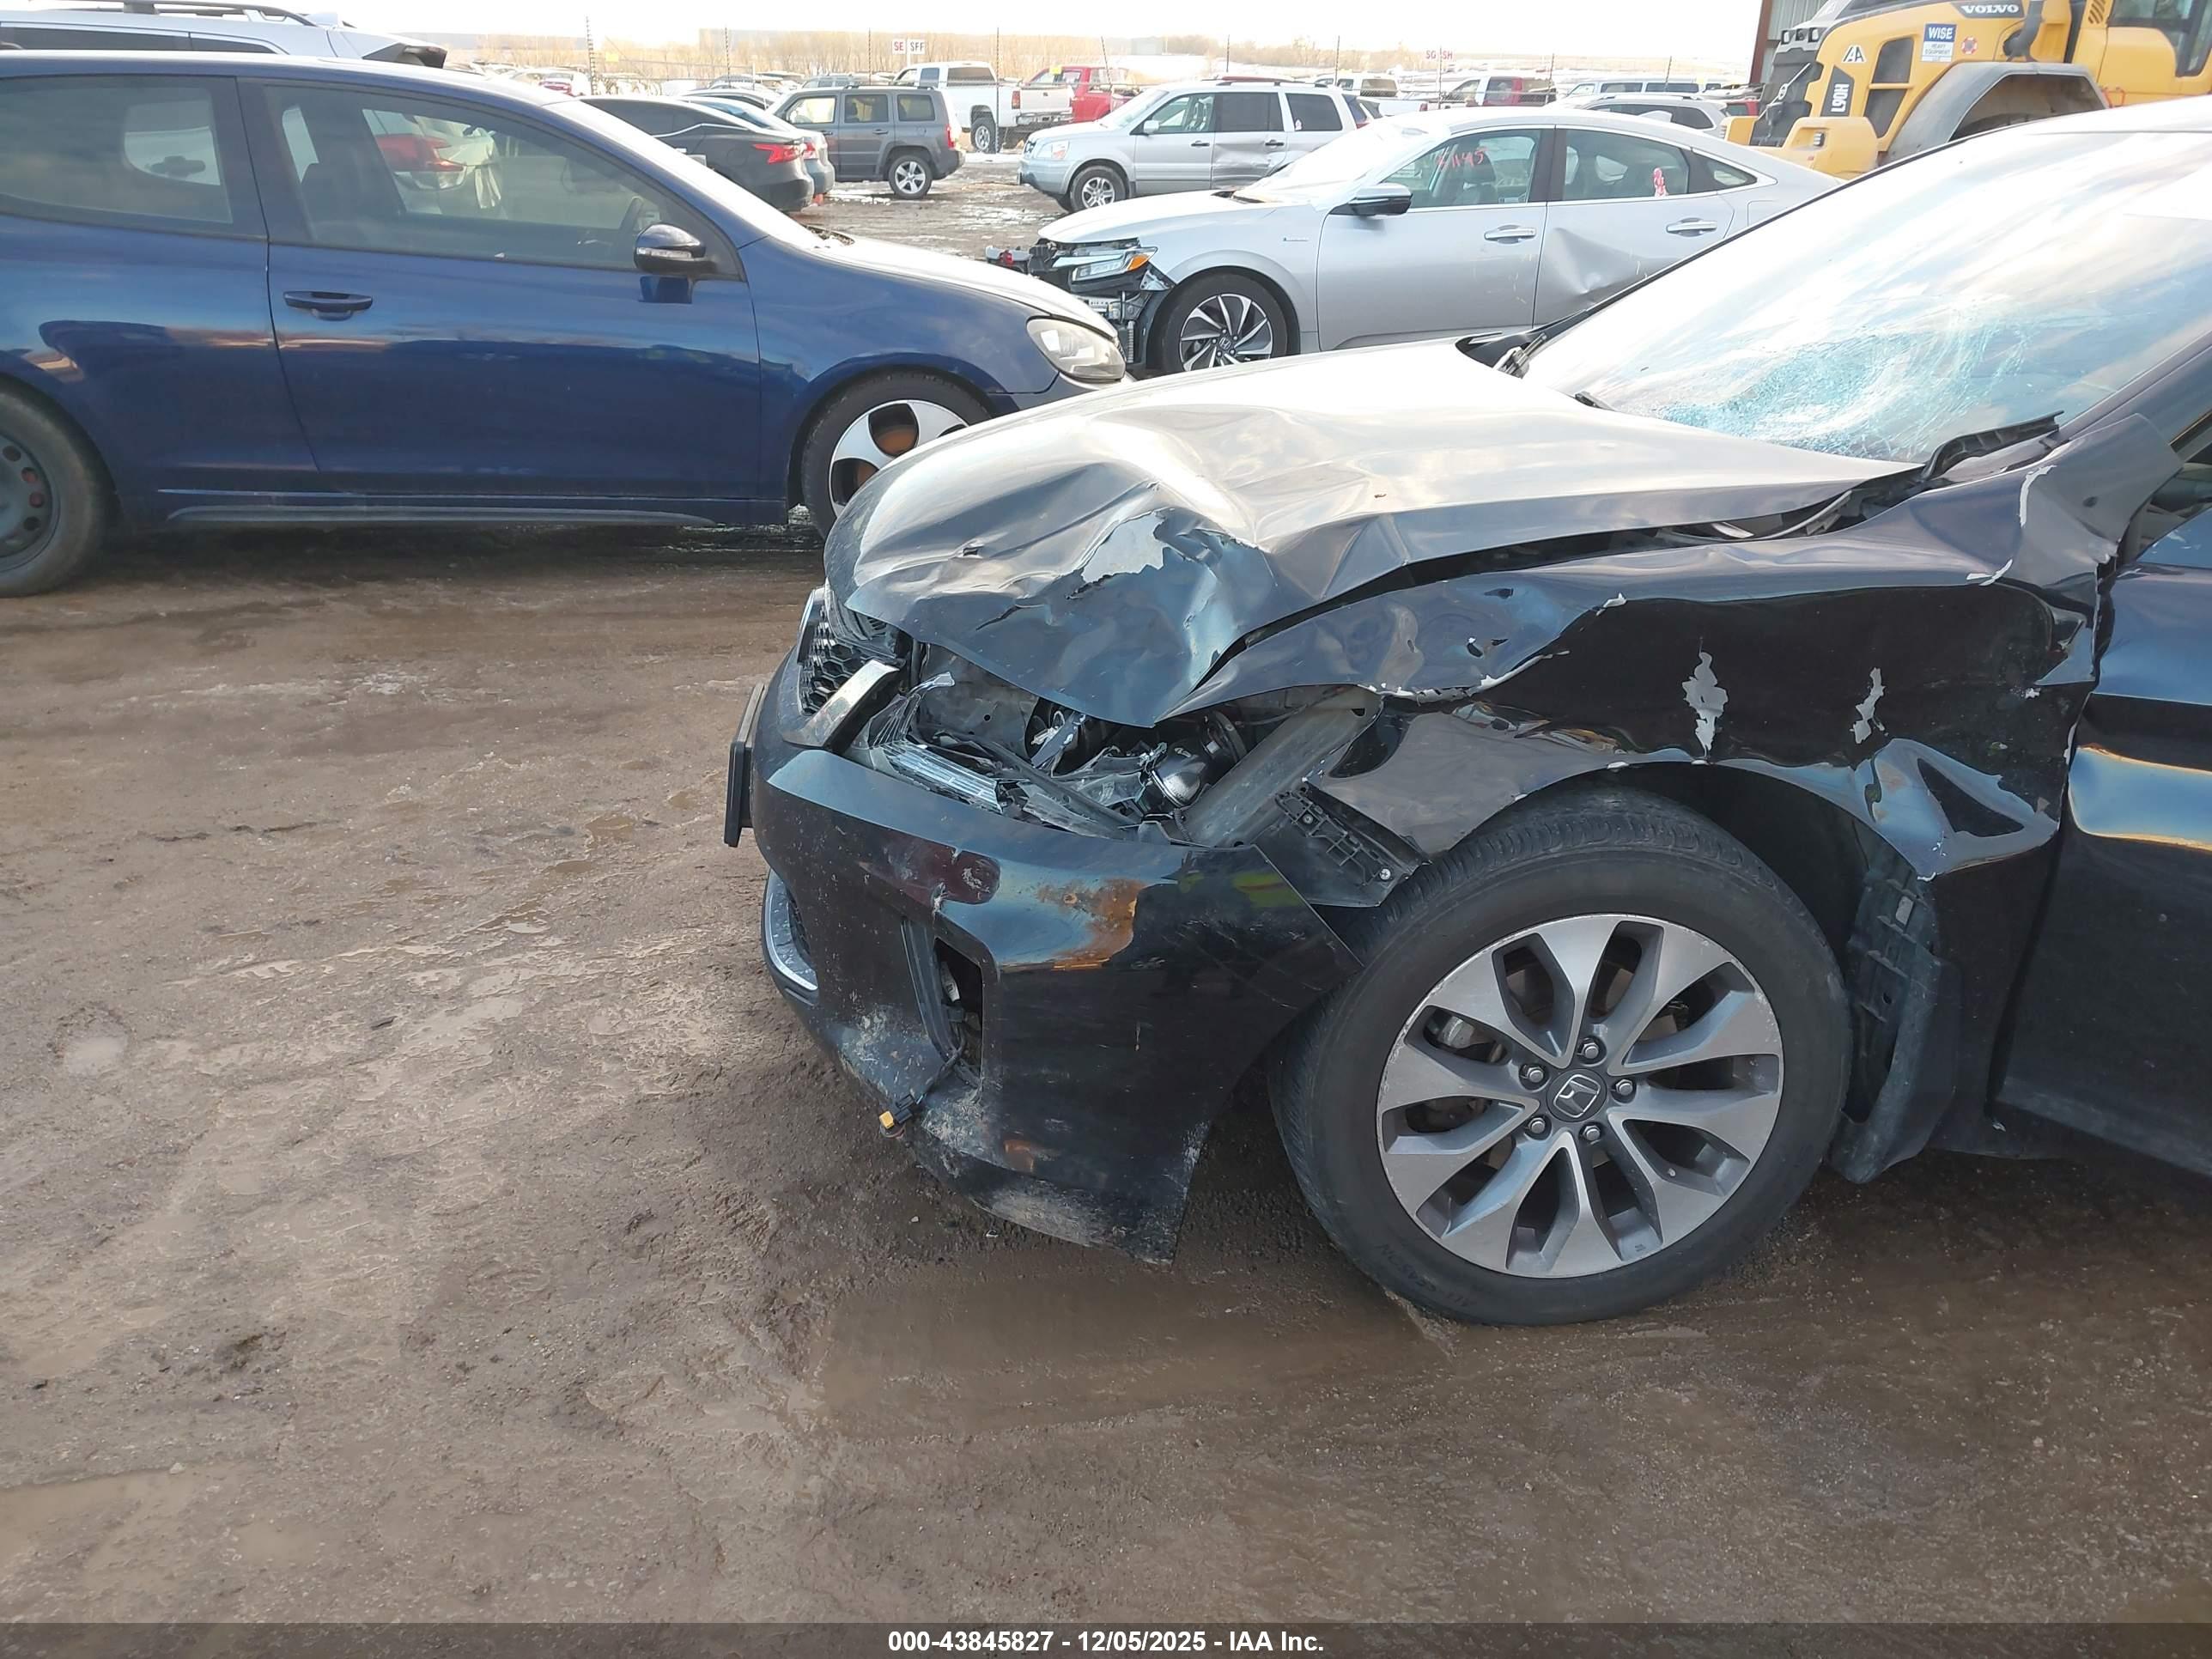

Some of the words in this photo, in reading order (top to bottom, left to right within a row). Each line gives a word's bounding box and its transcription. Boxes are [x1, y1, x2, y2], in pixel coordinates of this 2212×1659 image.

[1961, 4, 2019, 14] VOLVO
[1929, 27, 1954, 40] WISE
[894, 41, 904, 52] SE
[1443, 50, 1453, 60] SH
[1830, 83, 1850, 112] L90H
